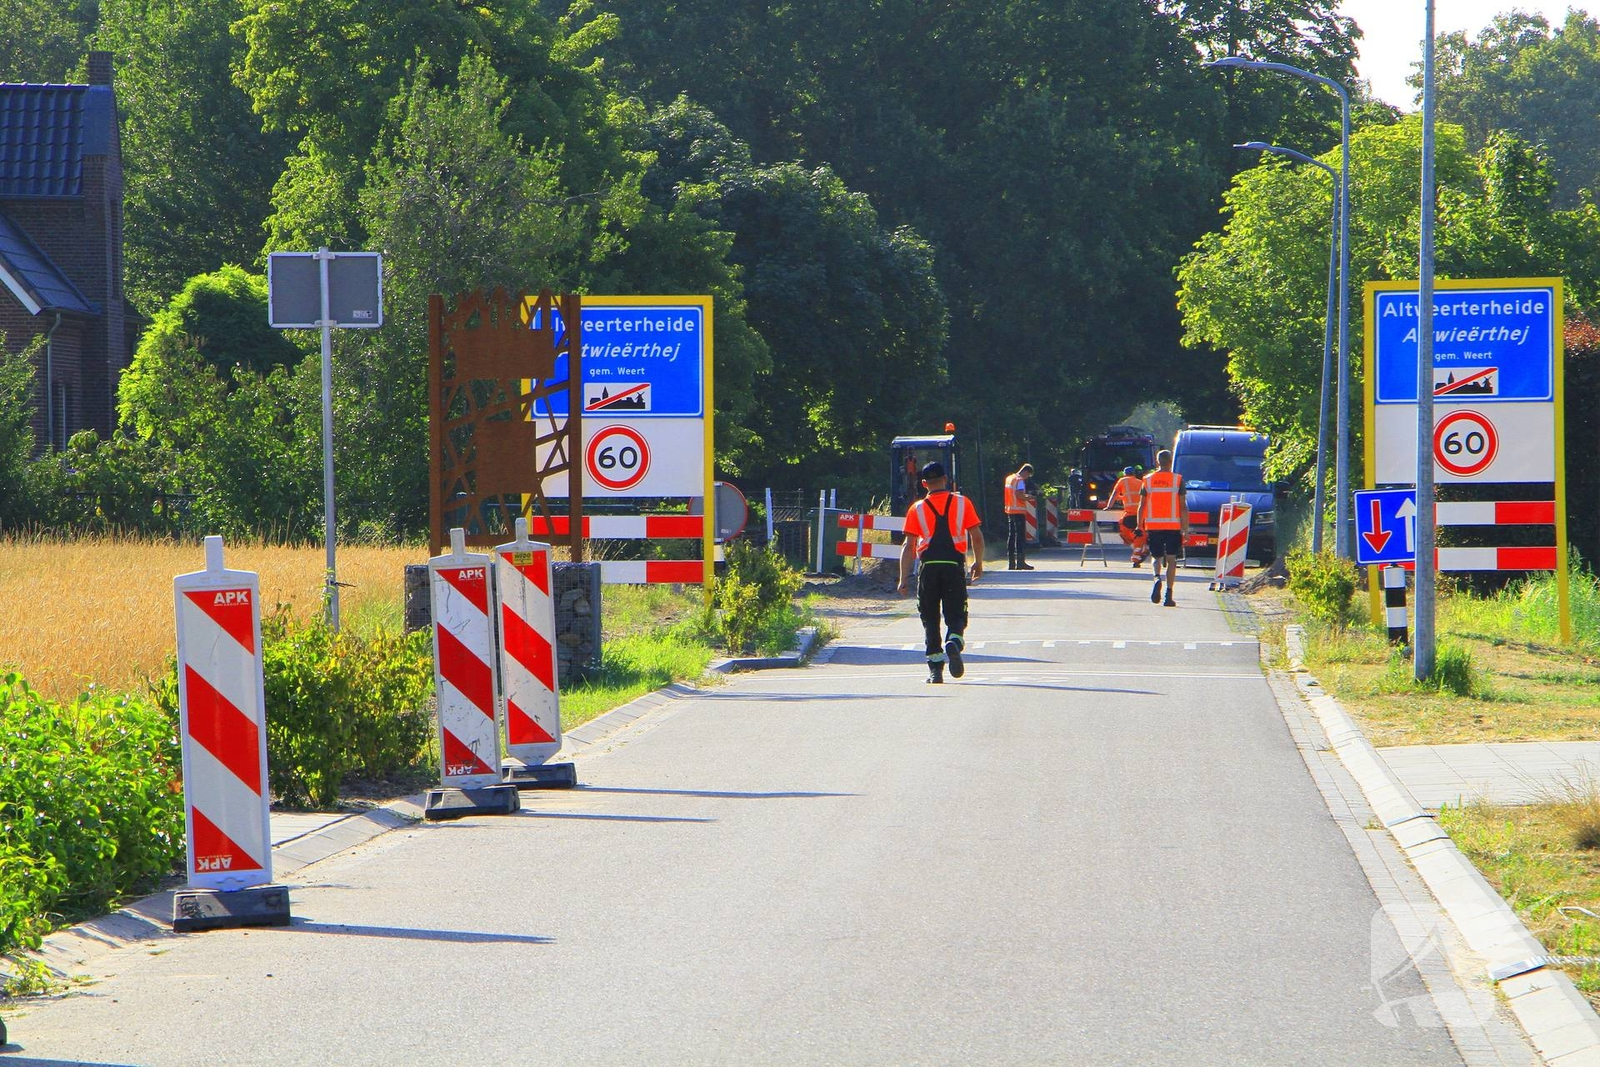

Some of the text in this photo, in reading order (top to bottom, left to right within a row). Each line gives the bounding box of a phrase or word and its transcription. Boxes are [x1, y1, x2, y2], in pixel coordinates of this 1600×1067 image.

[1383, 299, 1544, 317] Alteerterheide
[551, 316, 695, 332] leerterheide
[1402, 326, 1530, 345] Awieërthej
[581, 342, 681, 362] twieërthej
[1434, 350, 1493, 362] gem. Weert
[589, 366, 646, 376] gem. Weert
[1443, 431, 1486, 456] 60
[598, 446, 639, 470] 60
[458, 569, 484, 579] APK
[214, 591, 249, 604] APK
[197, 857, 232, 871] APK
